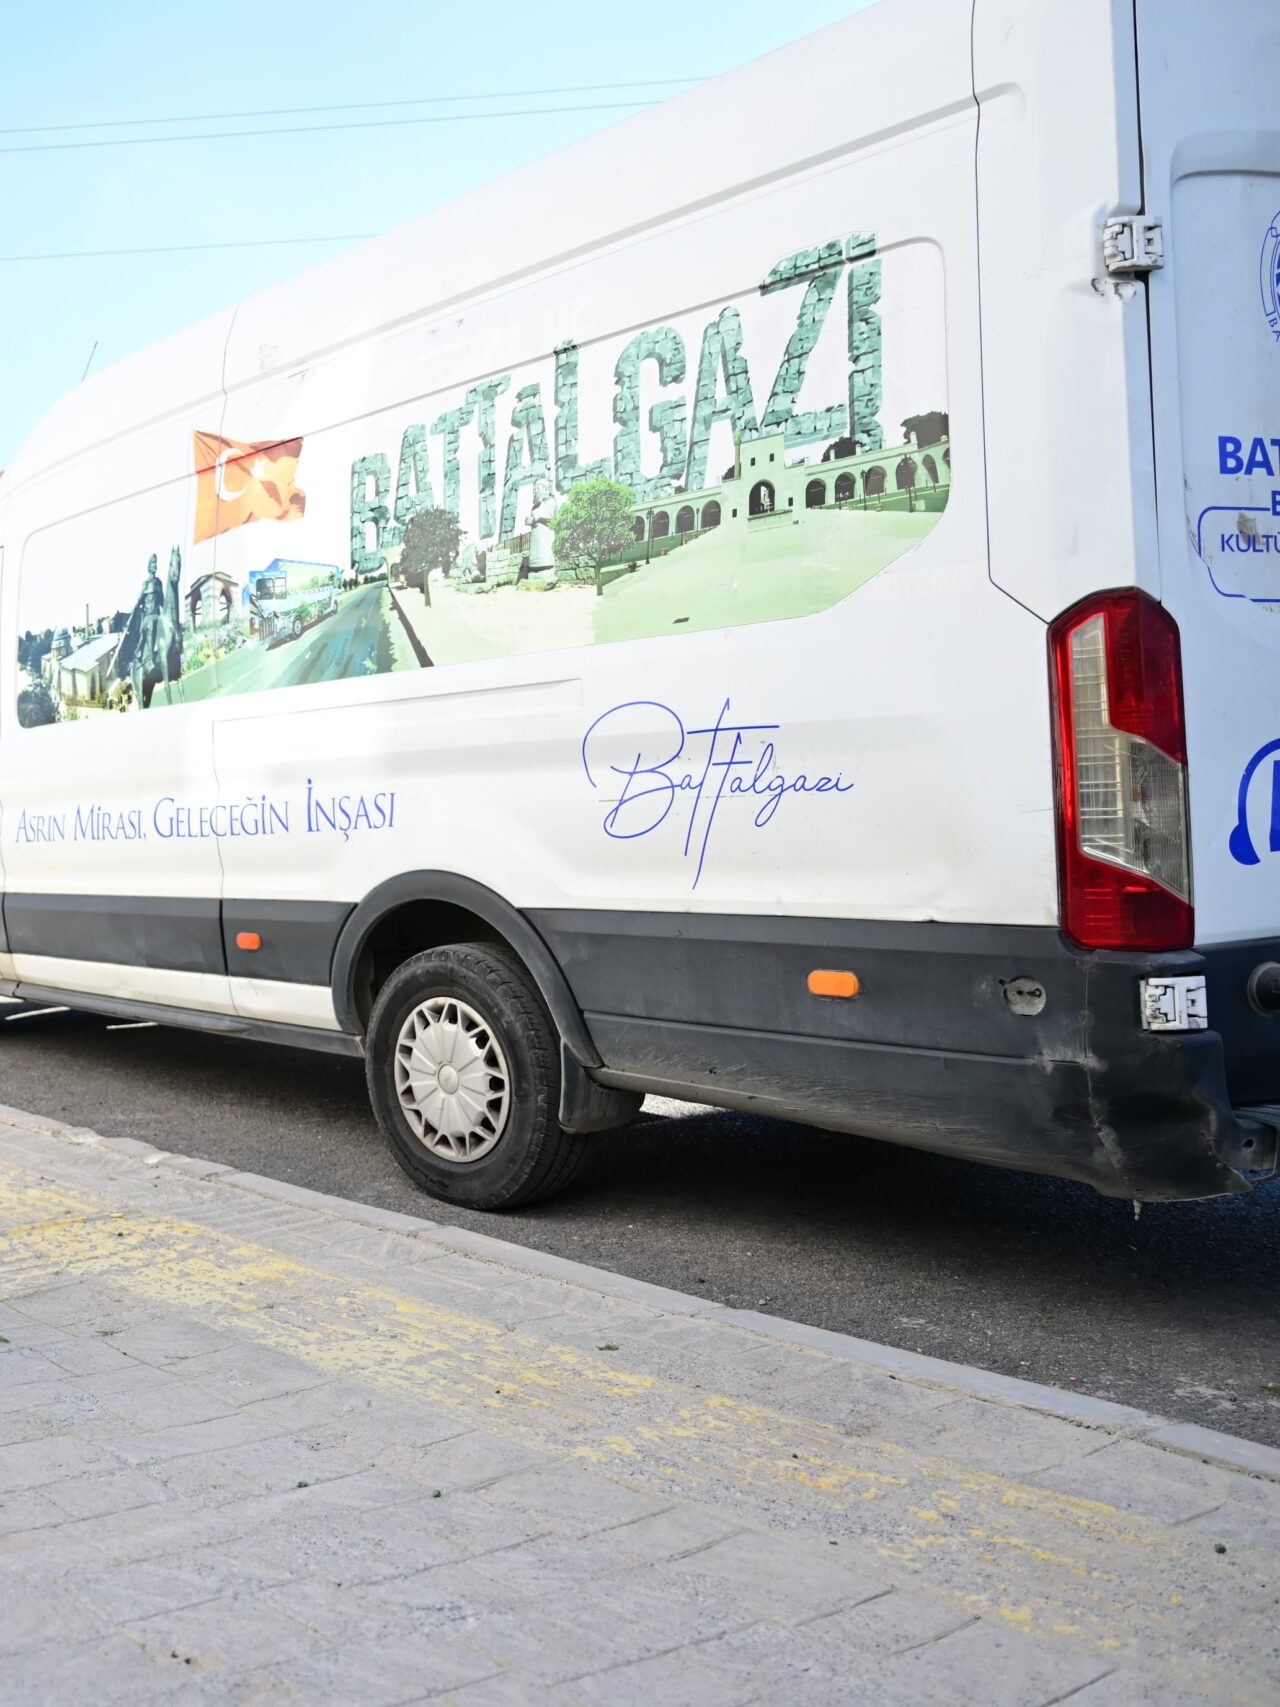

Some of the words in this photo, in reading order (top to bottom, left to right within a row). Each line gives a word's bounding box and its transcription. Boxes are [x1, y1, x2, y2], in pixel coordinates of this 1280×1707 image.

[16, 808, 66, 842] ASRIN
[153, 795, 290, 838] GELECEĞİN
[306, 778, 396, 842] İNŞASI
[582, 697, 854, 890] Battalgazi
